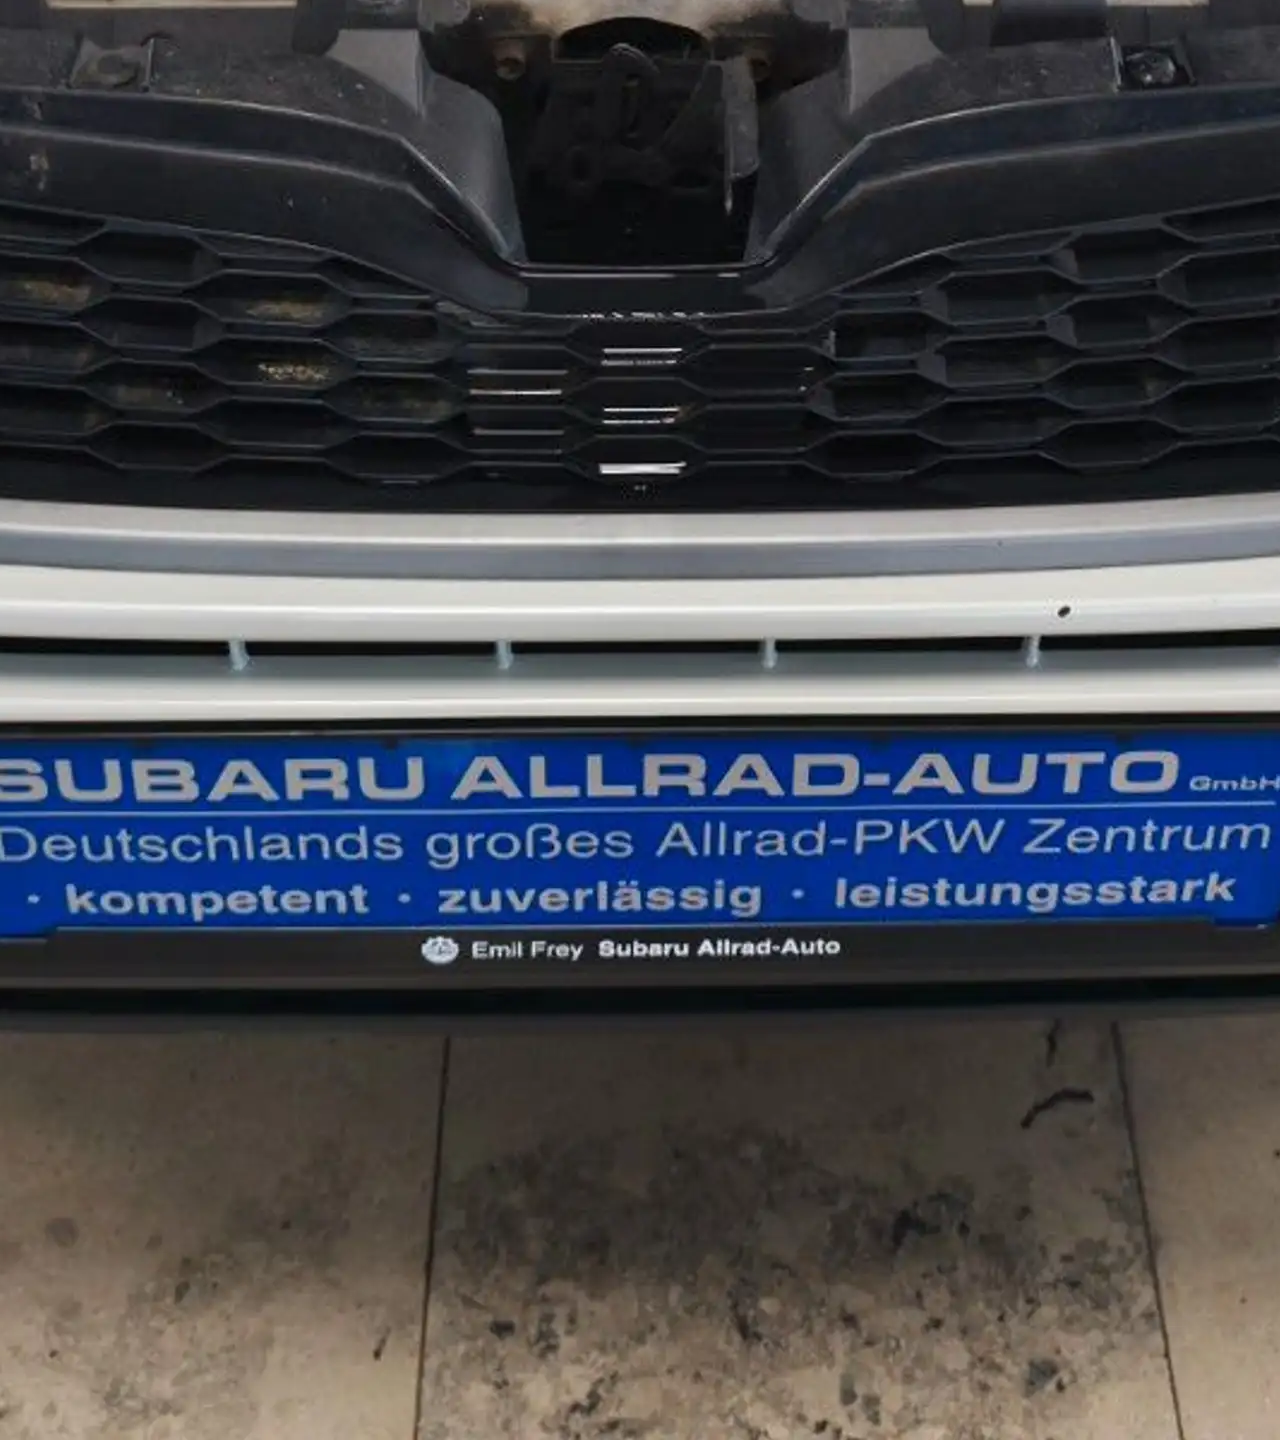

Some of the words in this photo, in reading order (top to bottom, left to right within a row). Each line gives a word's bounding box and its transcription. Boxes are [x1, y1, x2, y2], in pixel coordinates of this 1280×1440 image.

[451, 750, 1180, 801] ALLRAD-AUTO
[425, 821, 634, 870] großes
[655, 818, 1006, 858] Allrad-PKW
[1023, 816, 1271, 854] Zentrum
[65, 883, 369, 923] kompetent
[437, 879, 762, 918] zuverlässig
[834, 871, 1236, 913] leistungsstark
[470, 939, 523, 960] Emil
[530, 939, 585, 962] Frey
[598, 938, 690, 958] Subaru
[696, 936, 842, 958] Allrad-Auto
